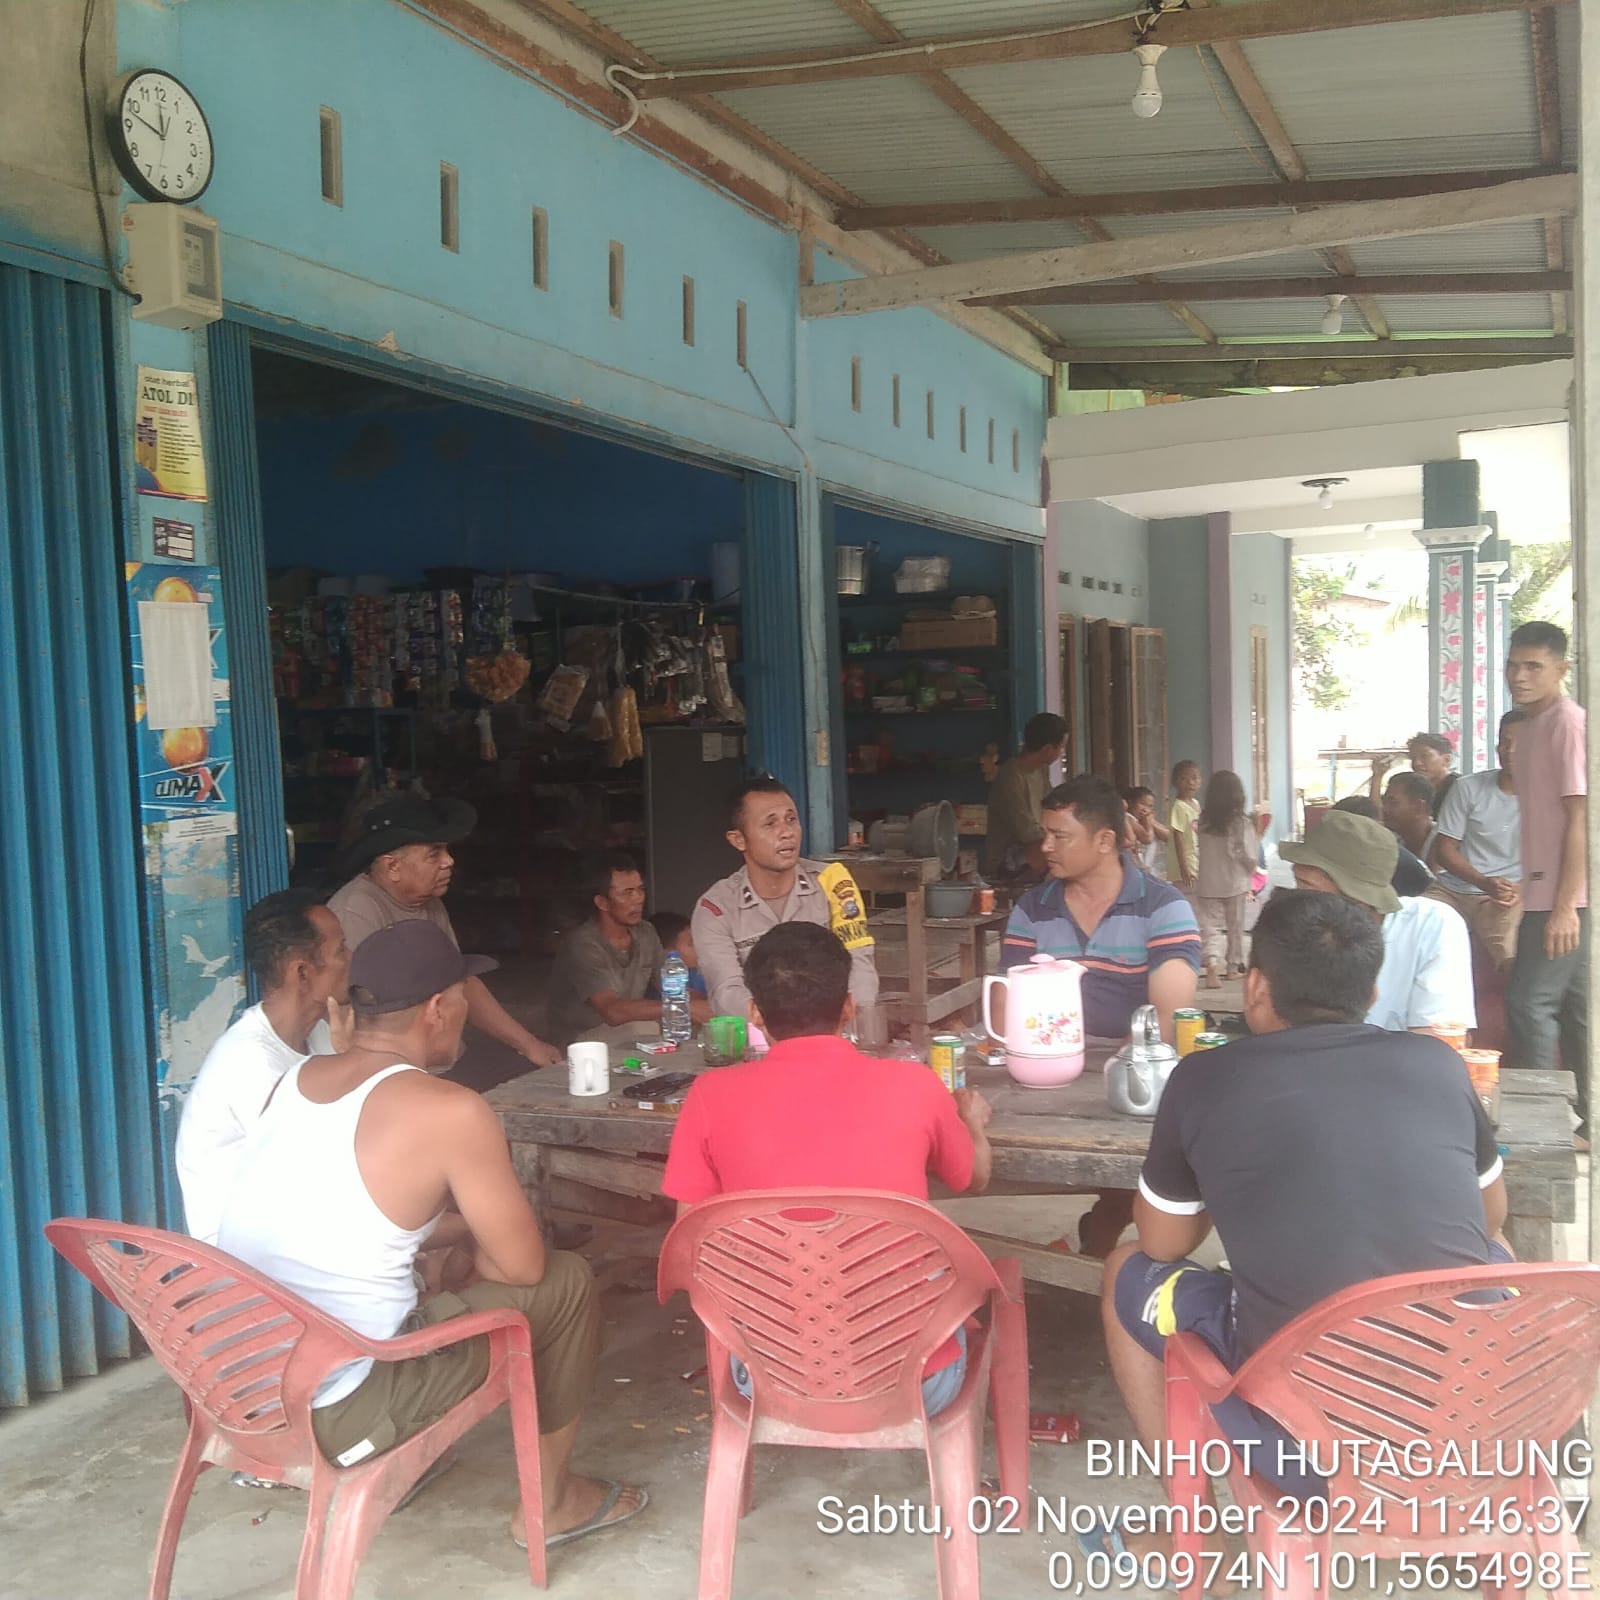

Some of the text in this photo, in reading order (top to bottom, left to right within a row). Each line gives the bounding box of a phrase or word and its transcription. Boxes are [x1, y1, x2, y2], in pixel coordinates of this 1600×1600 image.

[139, 86, 150, 102] 11
[153, 86, 167, 103] 12
[127, 98, 141, 114] 10
[173, 101, 180, 114] 1
[124, 118, 133, 132] 9
[185, 120, 193, 134] 2
[130, 142, 139, 157] 8
[189, 143, 198, 158] 3
[145, 163, 153, 178] 7
[185, 163, 194, 178] 4
[160, 174, 169, 189] 6
[176, 175, 184, 189] 5
